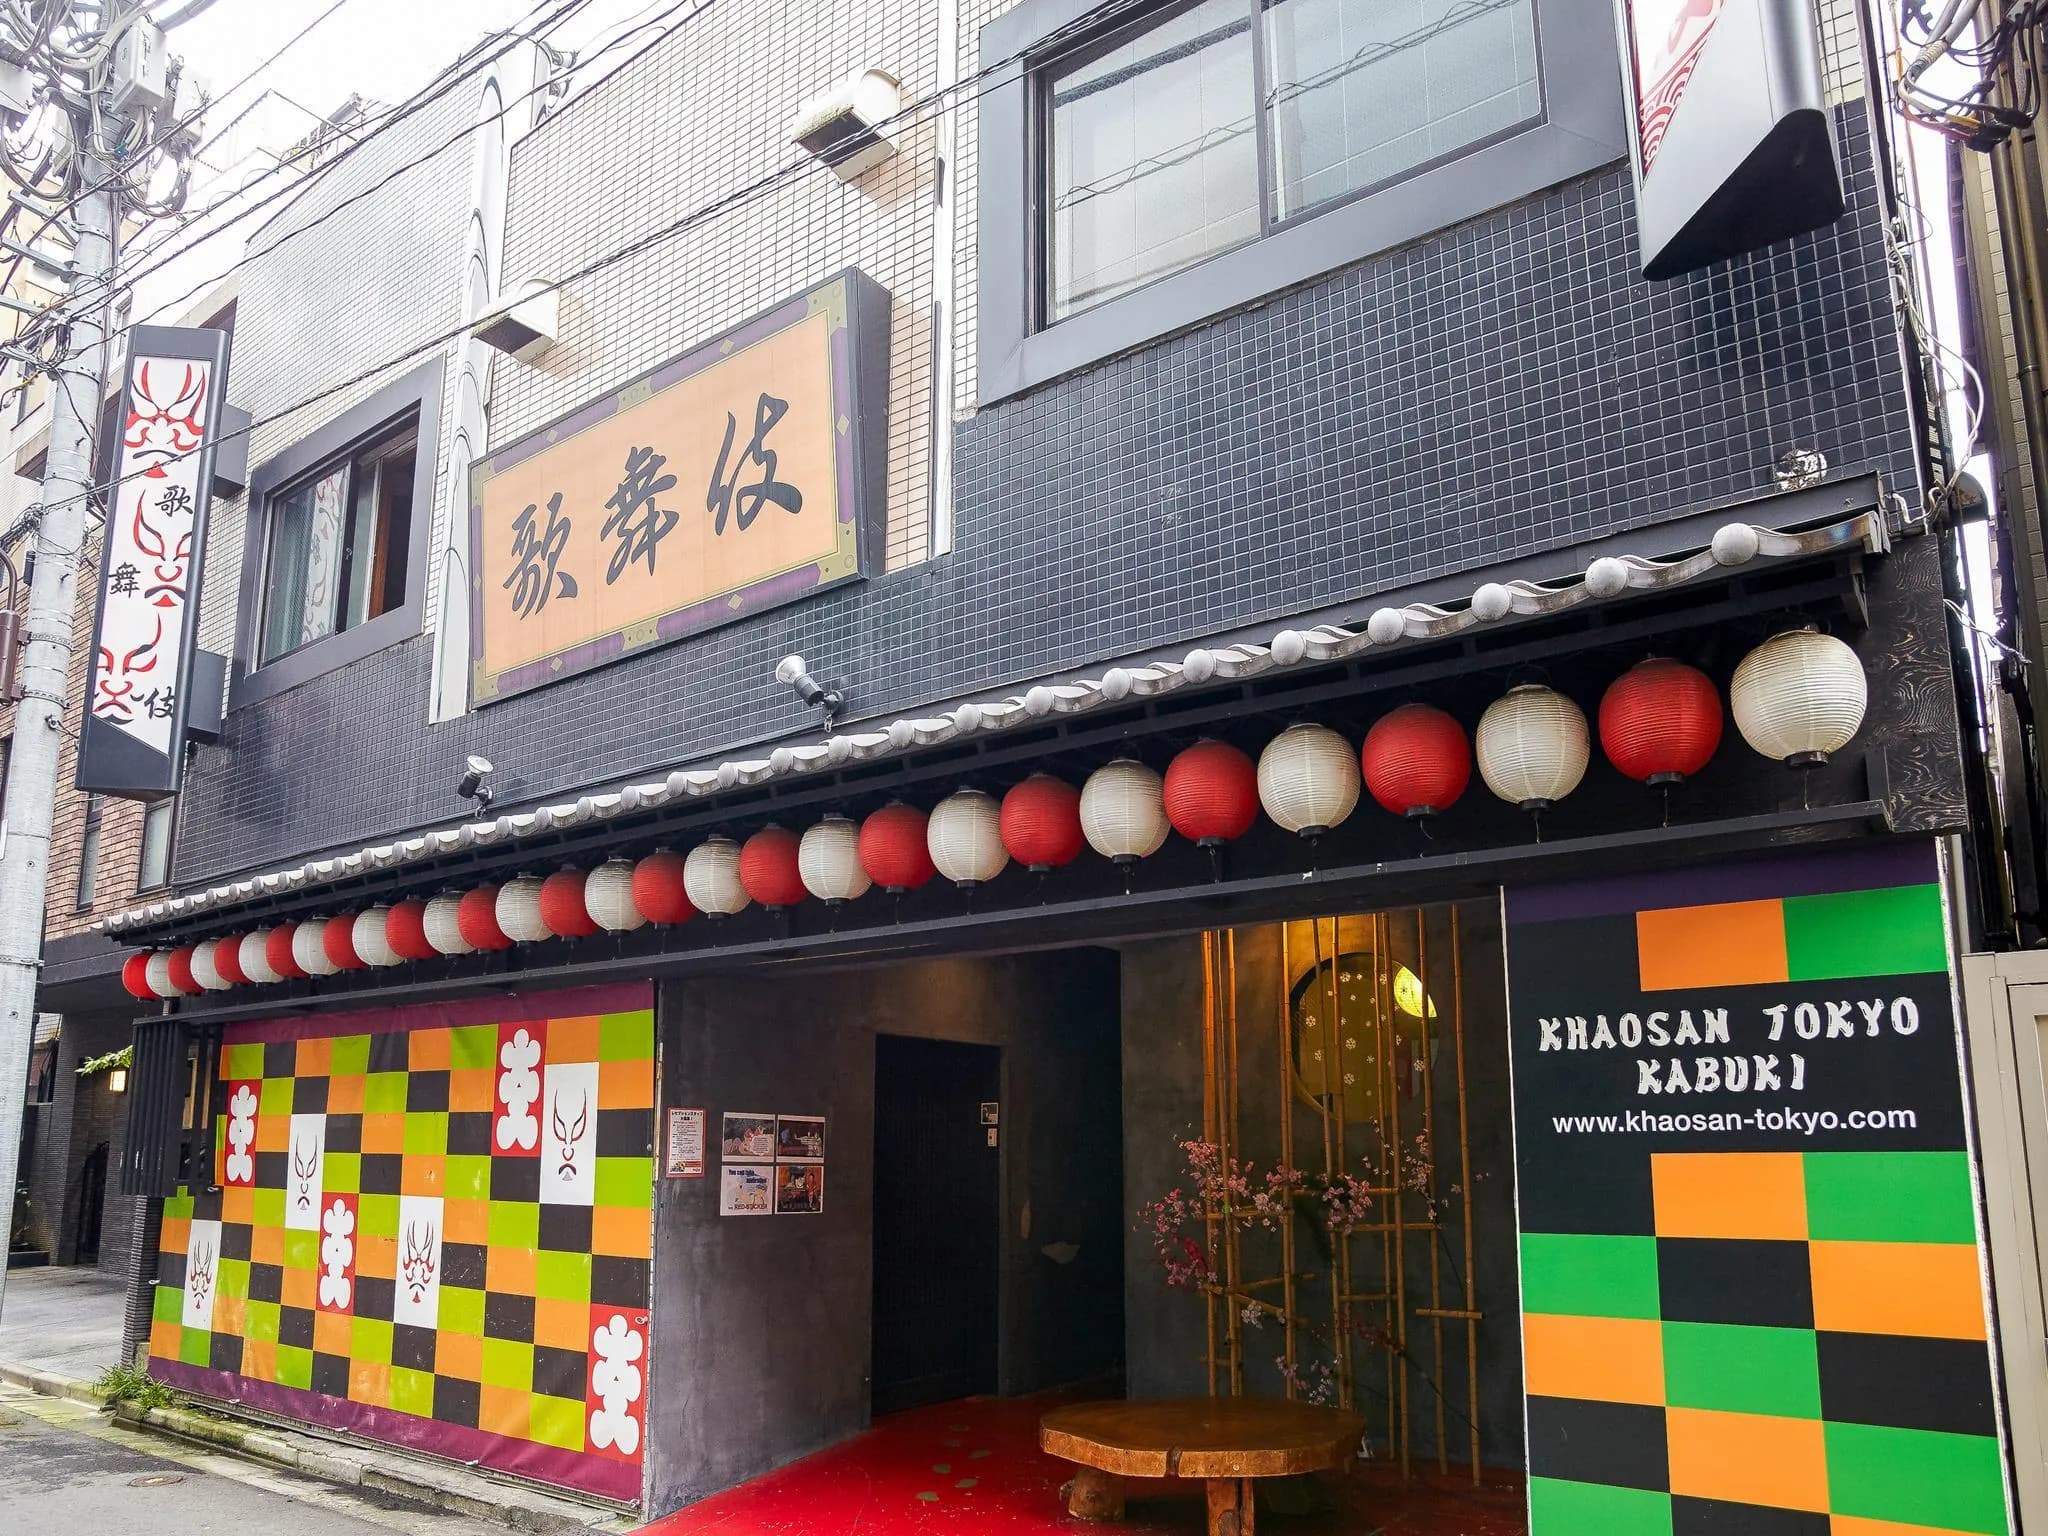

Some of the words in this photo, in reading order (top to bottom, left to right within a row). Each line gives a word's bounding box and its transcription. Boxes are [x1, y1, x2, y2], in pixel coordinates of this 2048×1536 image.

[502, 392, 803, 621] 歌舞伎
[1538, 1007, 1731, 1052] KHAOSAN
[1763, 996, 1919, 1041] TOKYO
[1637, 1053, 1805, 1095] KABUKI
[1552, 1106, 1917, 1136] www.khaosan-tokyo.com
